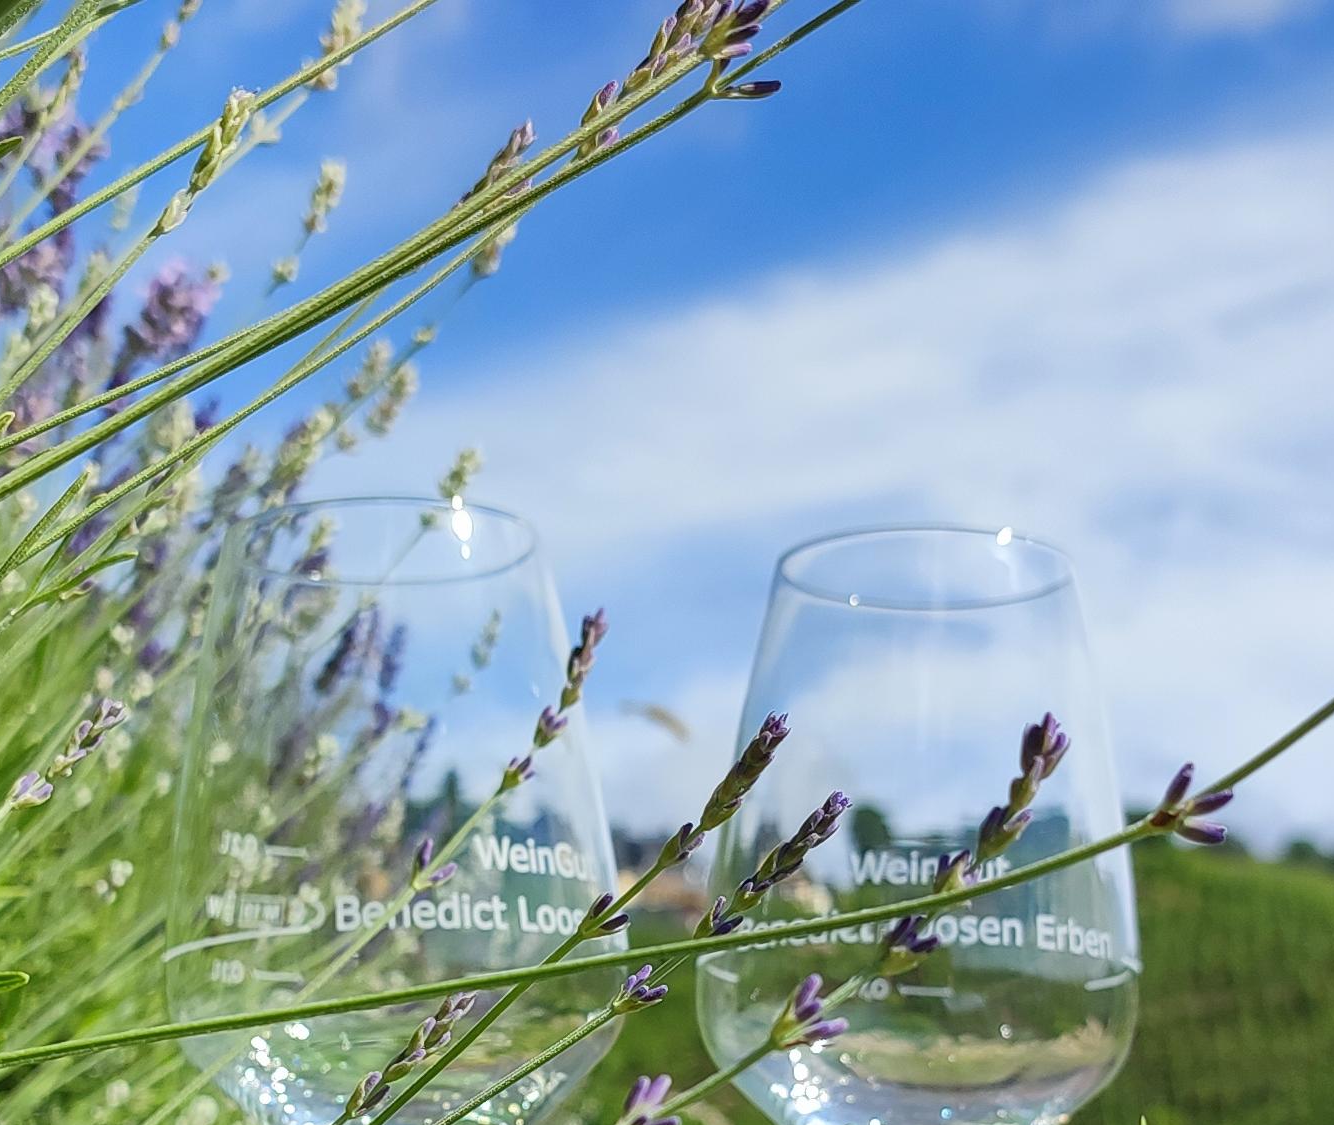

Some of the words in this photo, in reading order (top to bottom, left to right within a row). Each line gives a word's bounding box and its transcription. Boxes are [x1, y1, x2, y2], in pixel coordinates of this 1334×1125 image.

[472, 834, 591, 880] WeinGu
[851, 850, 1011, 886] Weinut
[335, 893, 509, 933] Benedict
[886, 912, 1023, 948] osen
[1036, 914, 1113, 960] Erben
